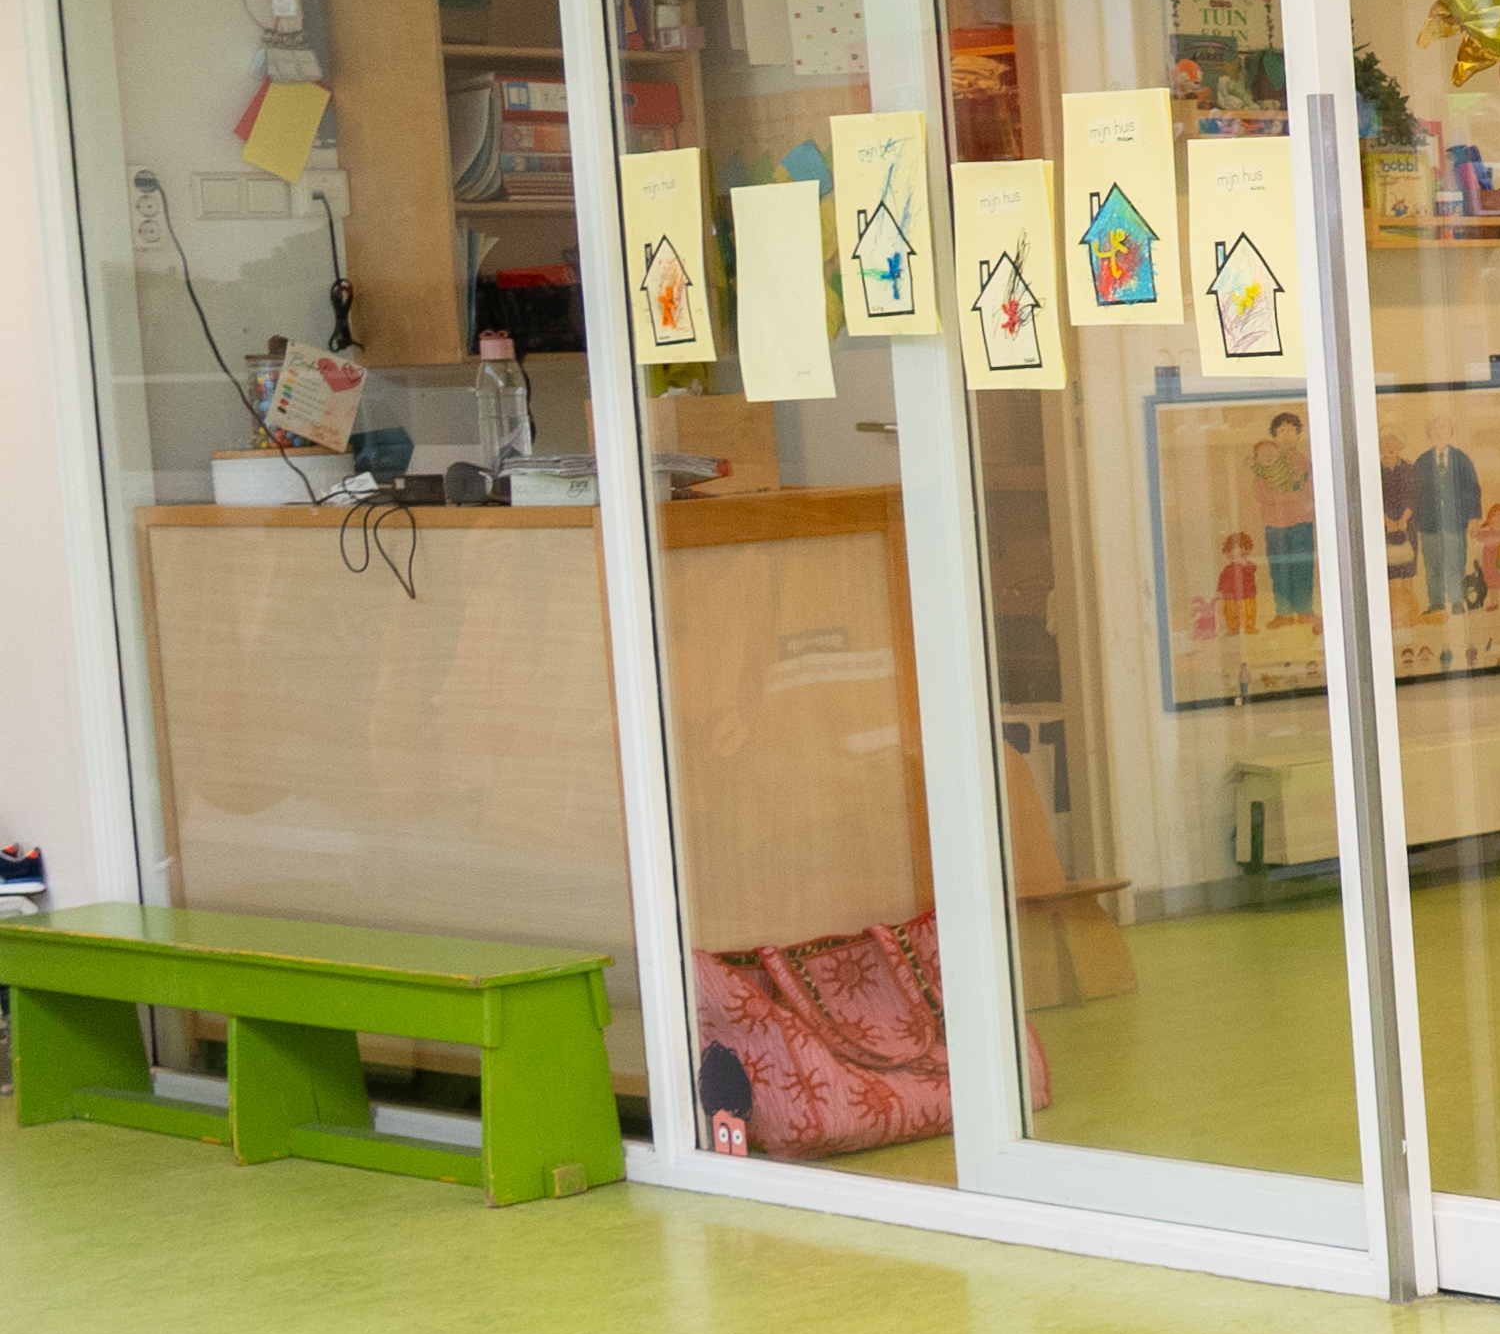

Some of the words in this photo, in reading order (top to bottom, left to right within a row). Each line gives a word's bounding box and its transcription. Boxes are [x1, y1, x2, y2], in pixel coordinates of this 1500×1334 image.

[1199, 8, 1248, 26] TUIN
[1089, 124, 1111, 144] mijn
[1114, 118, 1136, 135] huis
[1381, 158, 1419, 173] bobbi
[1217, 171, 1240, 192] mijn
[1242, 166, 1263, 182] huis
[980, 193, 1001, 213] mijn
[1002, 188, 1021, 205] huis
